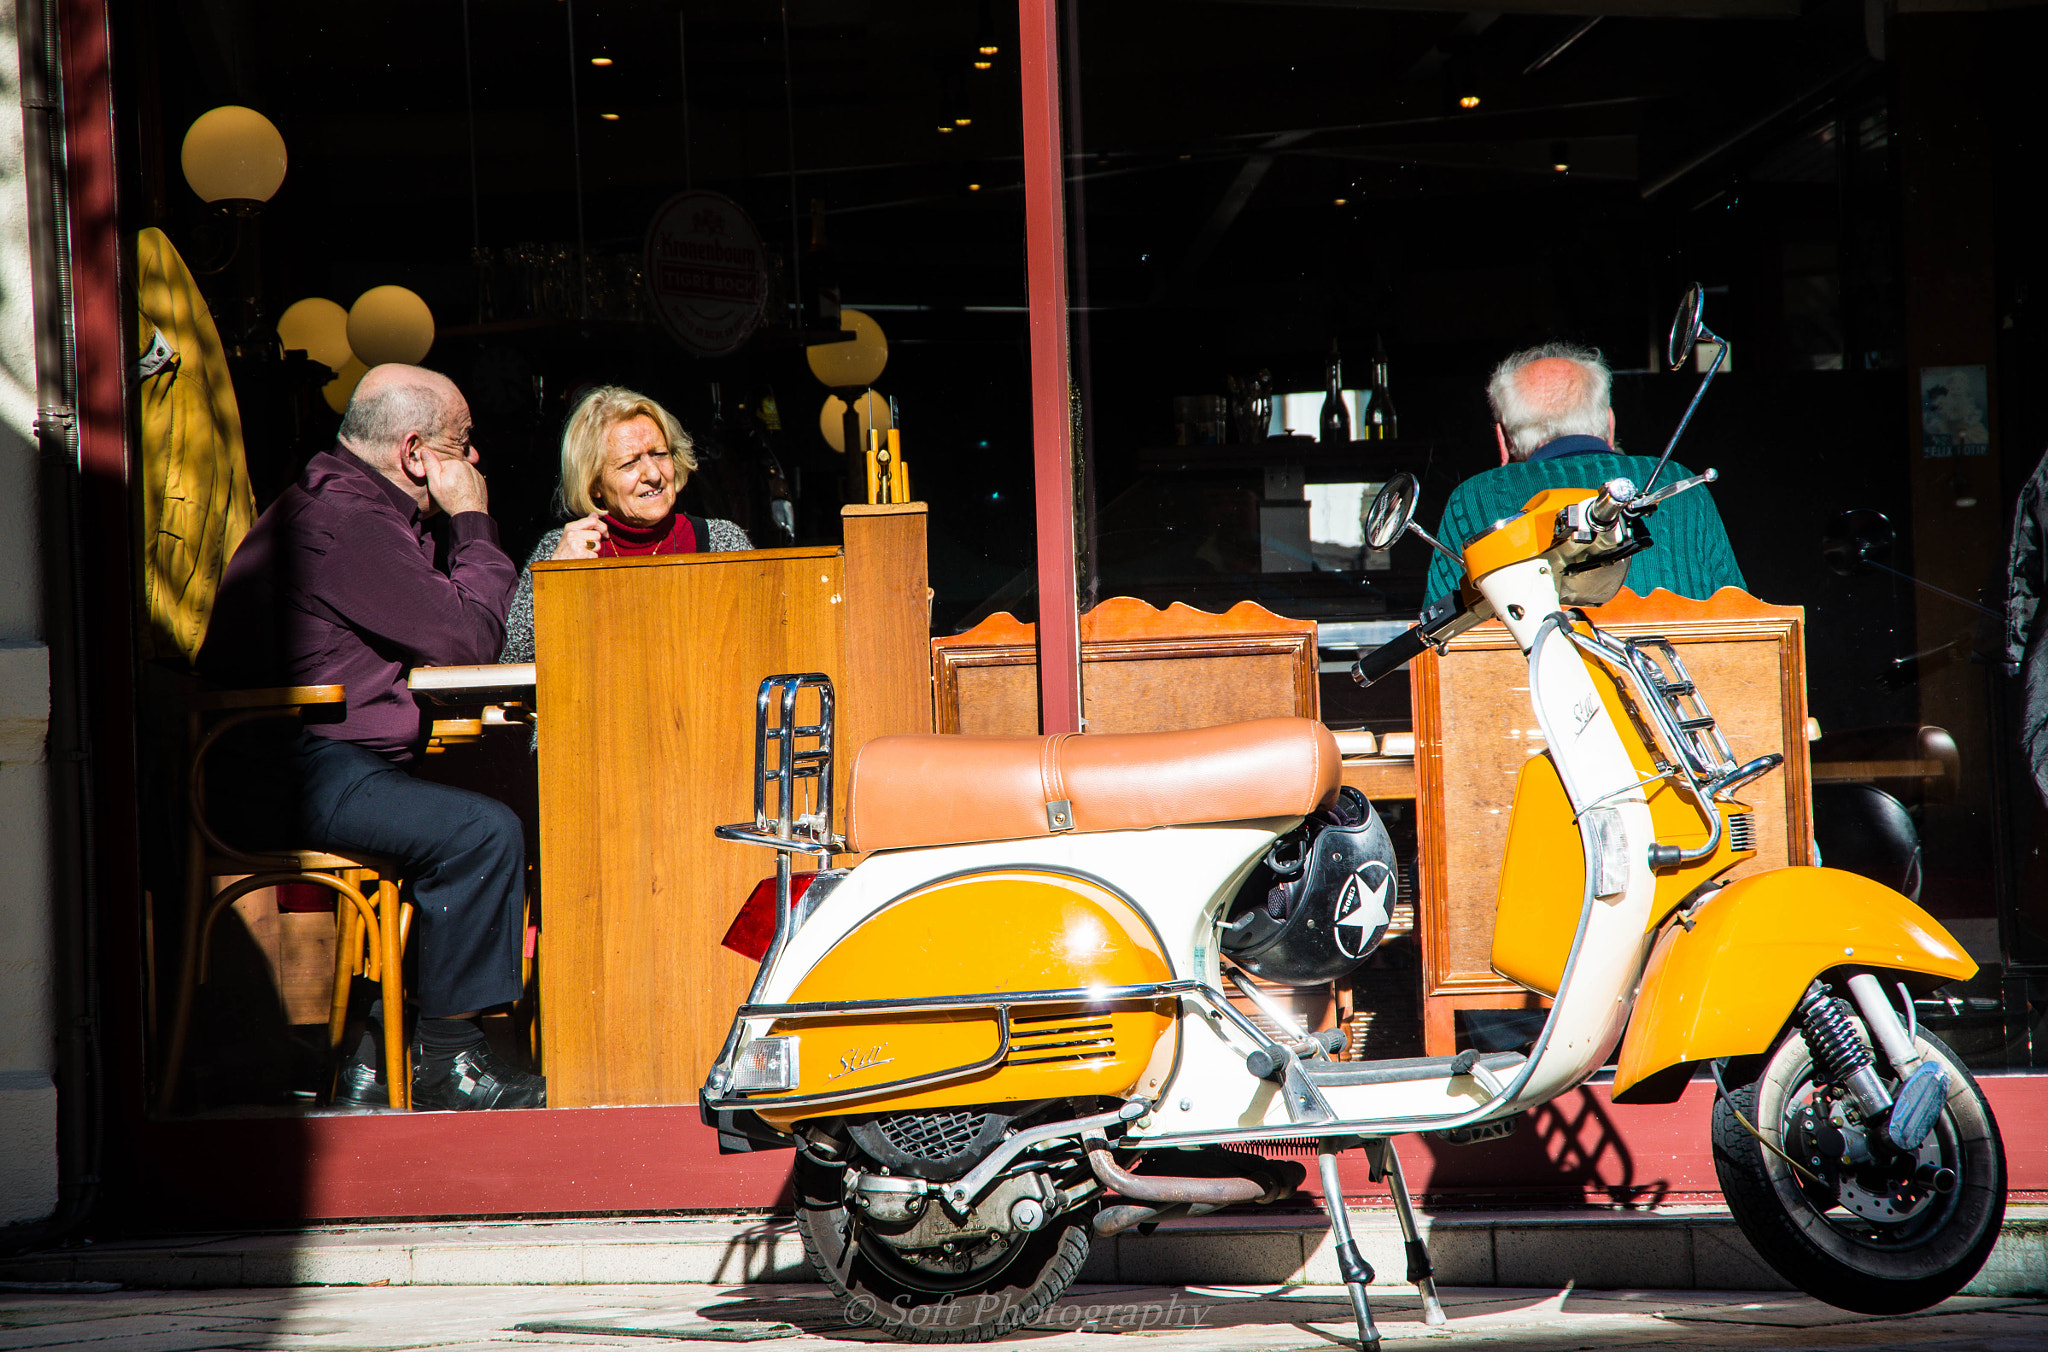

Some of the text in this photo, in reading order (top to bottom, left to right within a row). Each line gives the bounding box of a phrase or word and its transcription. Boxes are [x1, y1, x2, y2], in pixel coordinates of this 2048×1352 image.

[663, 271, 754, 294] TIGRE BOCK
[1341, 885, 1356, 914] CHOK
